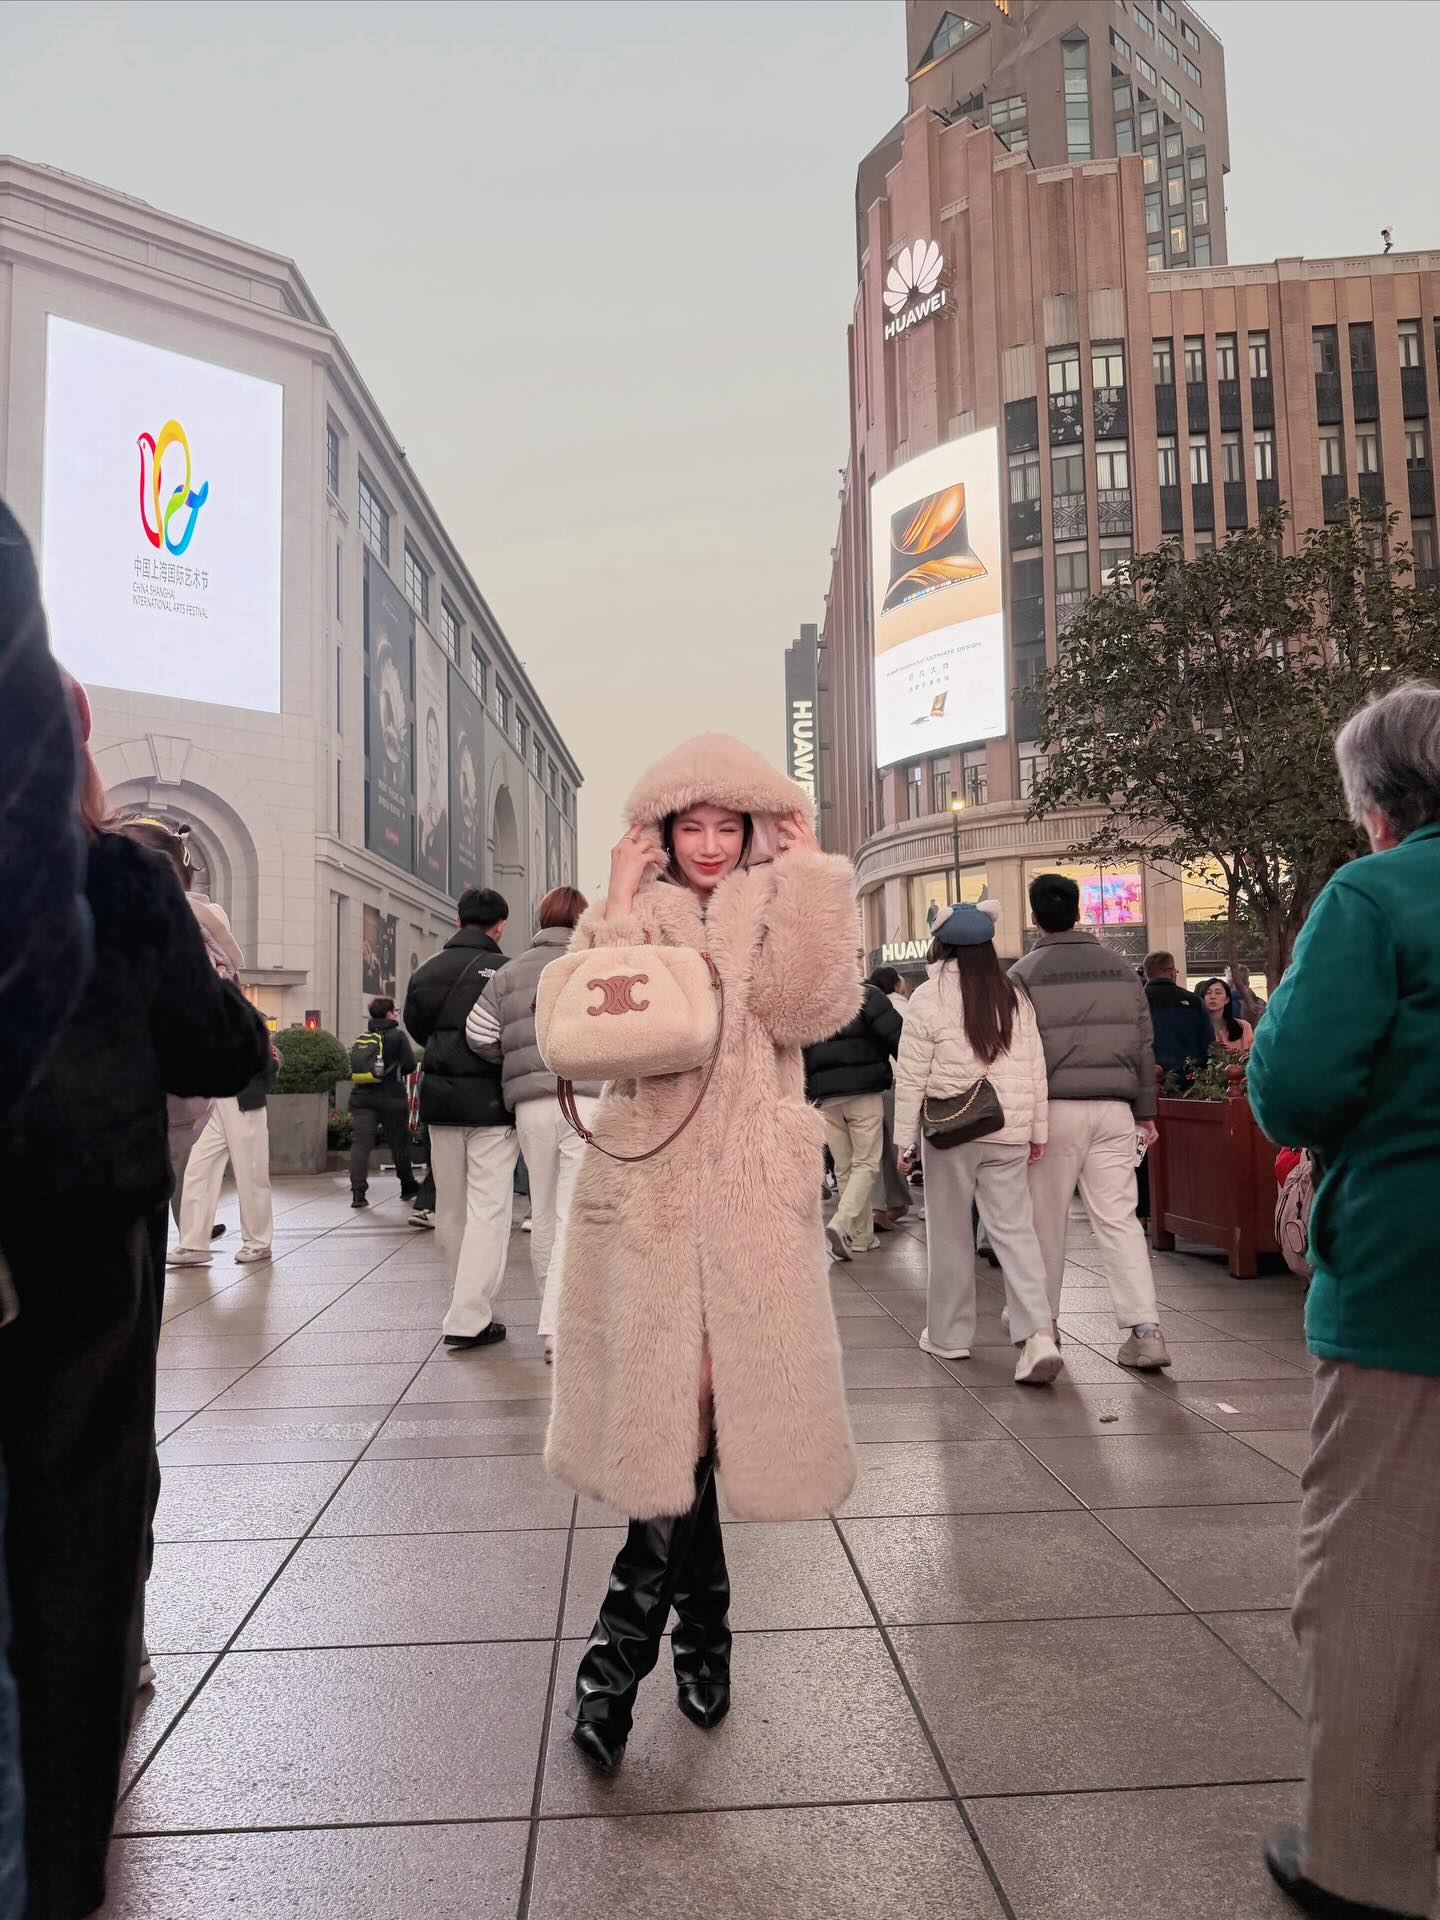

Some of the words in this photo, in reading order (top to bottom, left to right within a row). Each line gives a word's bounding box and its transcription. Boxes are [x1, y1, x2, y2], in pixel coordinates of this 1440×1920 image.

[884, 290, 946, 340] HUAWEI
[134, 555, 209, 591] 中国上海国际艺术节
